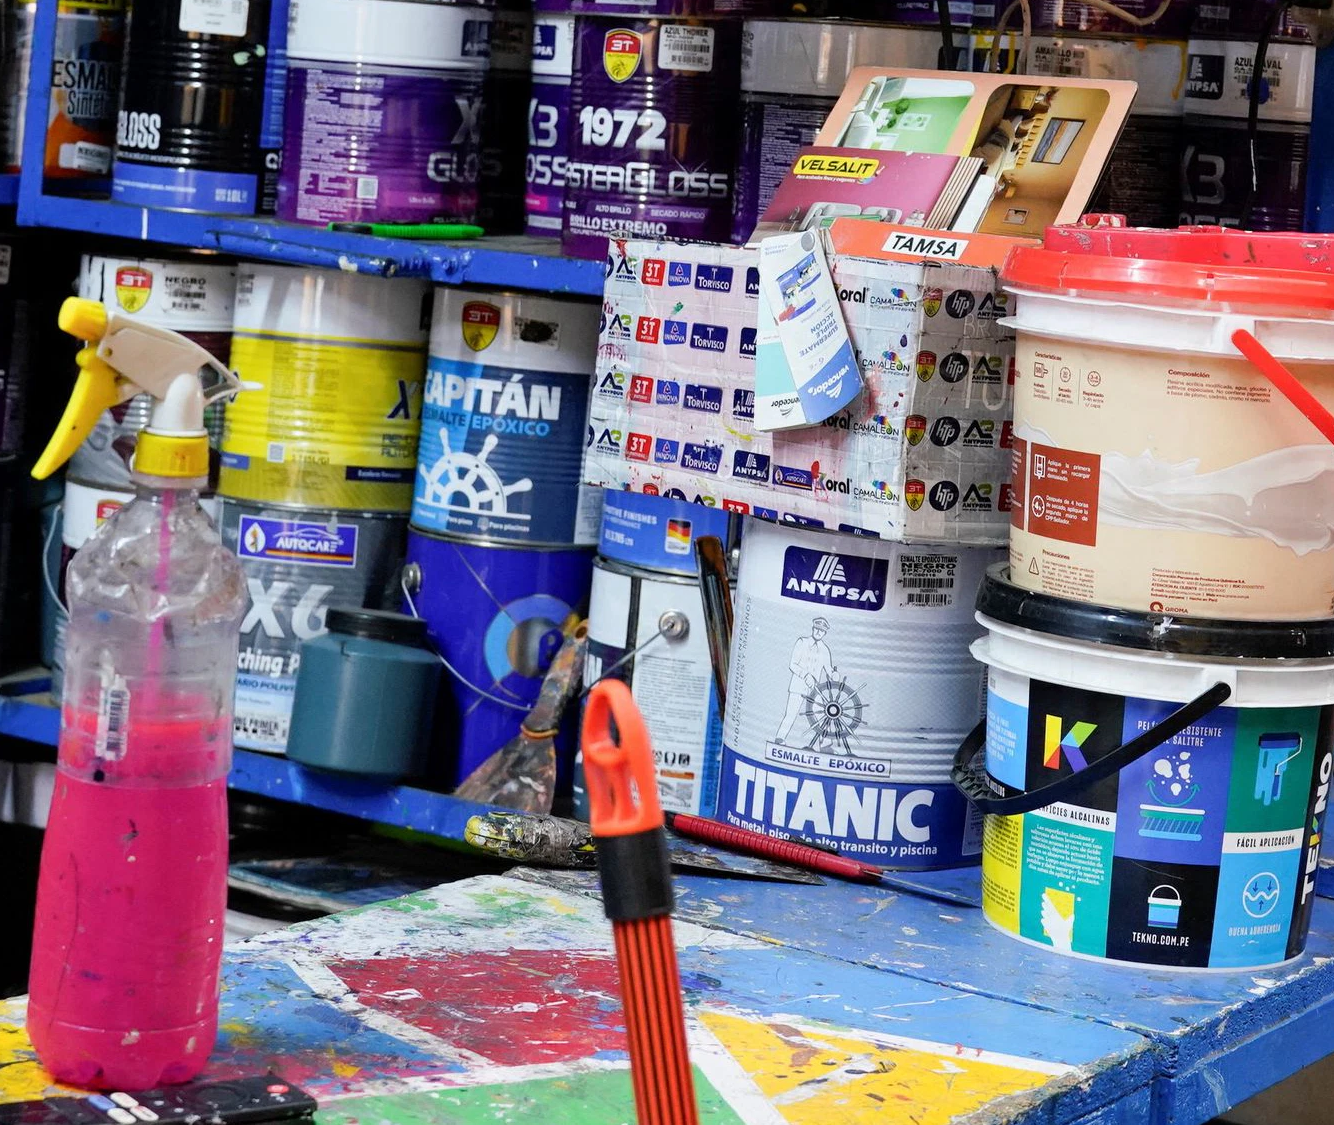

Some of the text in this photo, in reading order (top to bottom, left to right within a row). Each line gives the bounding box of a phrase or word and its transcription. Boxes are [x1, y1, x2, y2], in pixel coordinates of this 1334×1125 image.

[578, 104, 668, 152] 1972
[800, 159, 874, 175] VELSALIT
[601, 217, 668, 235] EXTREMO
[892, 235, 958, 257] TAMSA
[693, 337, 724, 351] TORVISCO
[424, 373, 563, 421] CAPITÁN
[687, 396, 720, 412] TORVISCO
[473, 415, 551, 437] EPÓXICO
[684, 455, 718, 472] TORVISCO
[276, 537, 338, 553] AUTOCARE
[786, 577, 875, 603] ANYPSA
[240, 577, 335, 639] X6
[1173, 735, 1204, 747] SALITRE
[772, 748, 886, 773] ESMALTE EPÓXICO
[733, 759, 935, 843] TITANIC
[1069, 808, 1111, 826] ALCALINAS
[840, 839, 938, 857] transito y piscina
[1236, 833, 1296, 848] FÁCIL APLICACIÓN
[1132, 930, 1190, 948] TEKNO.COM.PE
